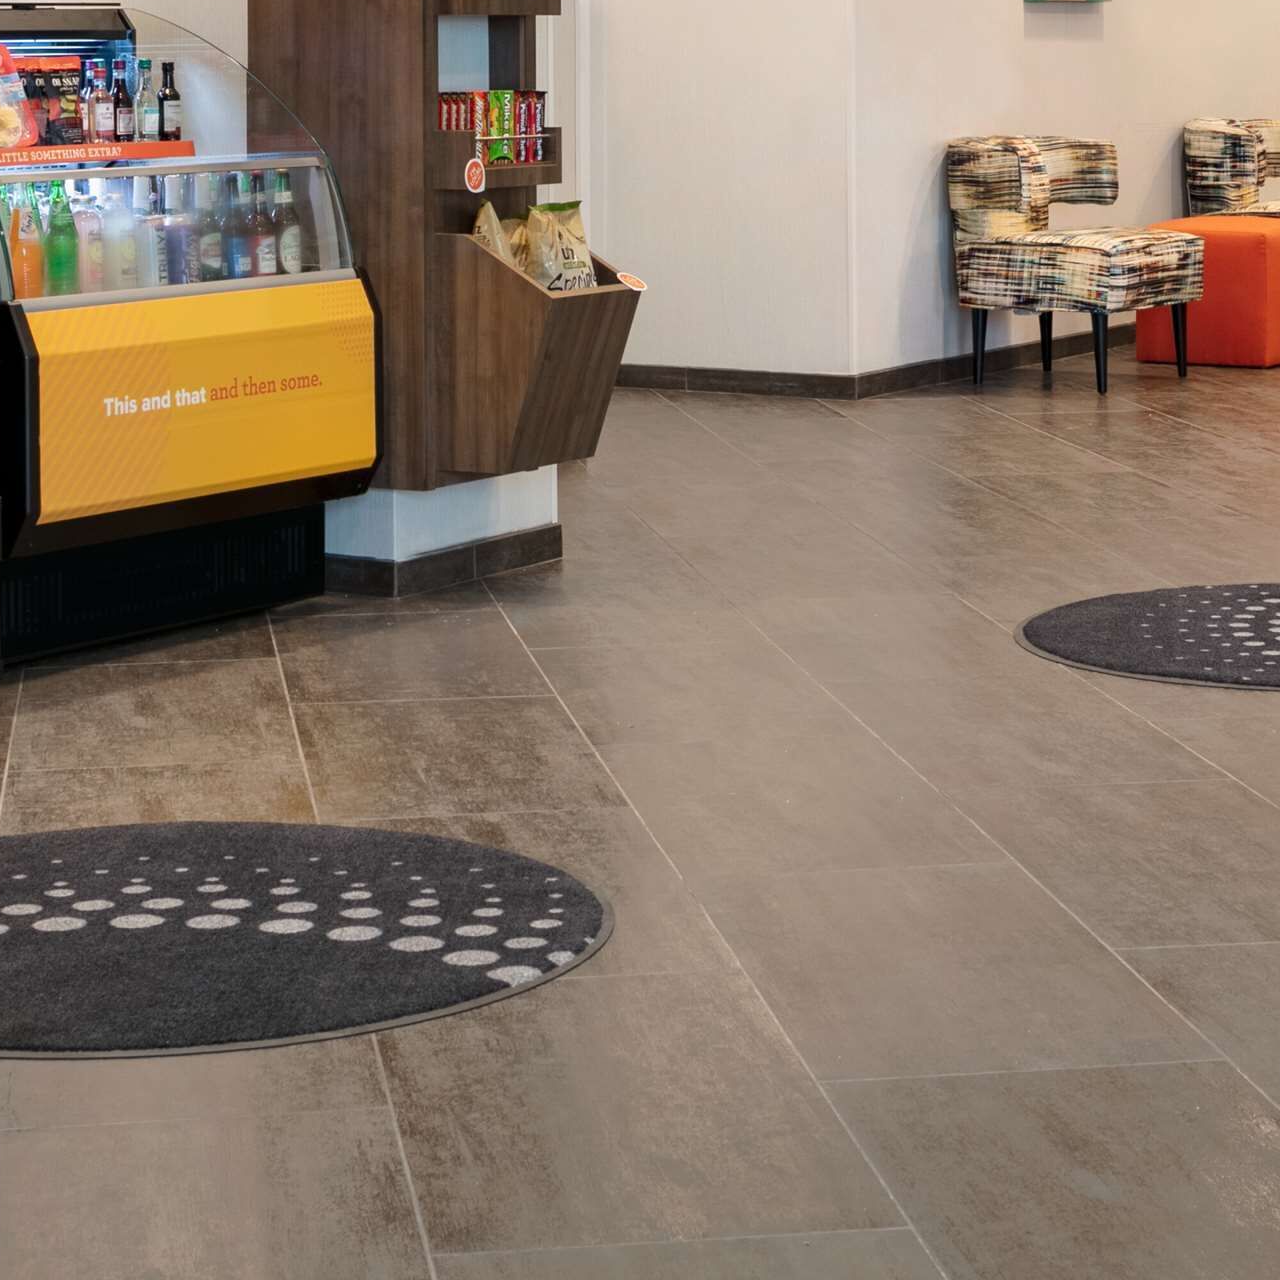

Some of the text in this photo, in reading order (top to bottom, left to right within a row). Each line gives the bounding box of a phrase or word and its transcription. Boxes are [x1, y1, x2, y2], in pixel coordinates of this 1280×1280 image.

[30, 148, 87, 161] SOMETHING
[88, 146, 123, 158] EXTRA?
[104, 374, 323, 416] This and that and then some.
